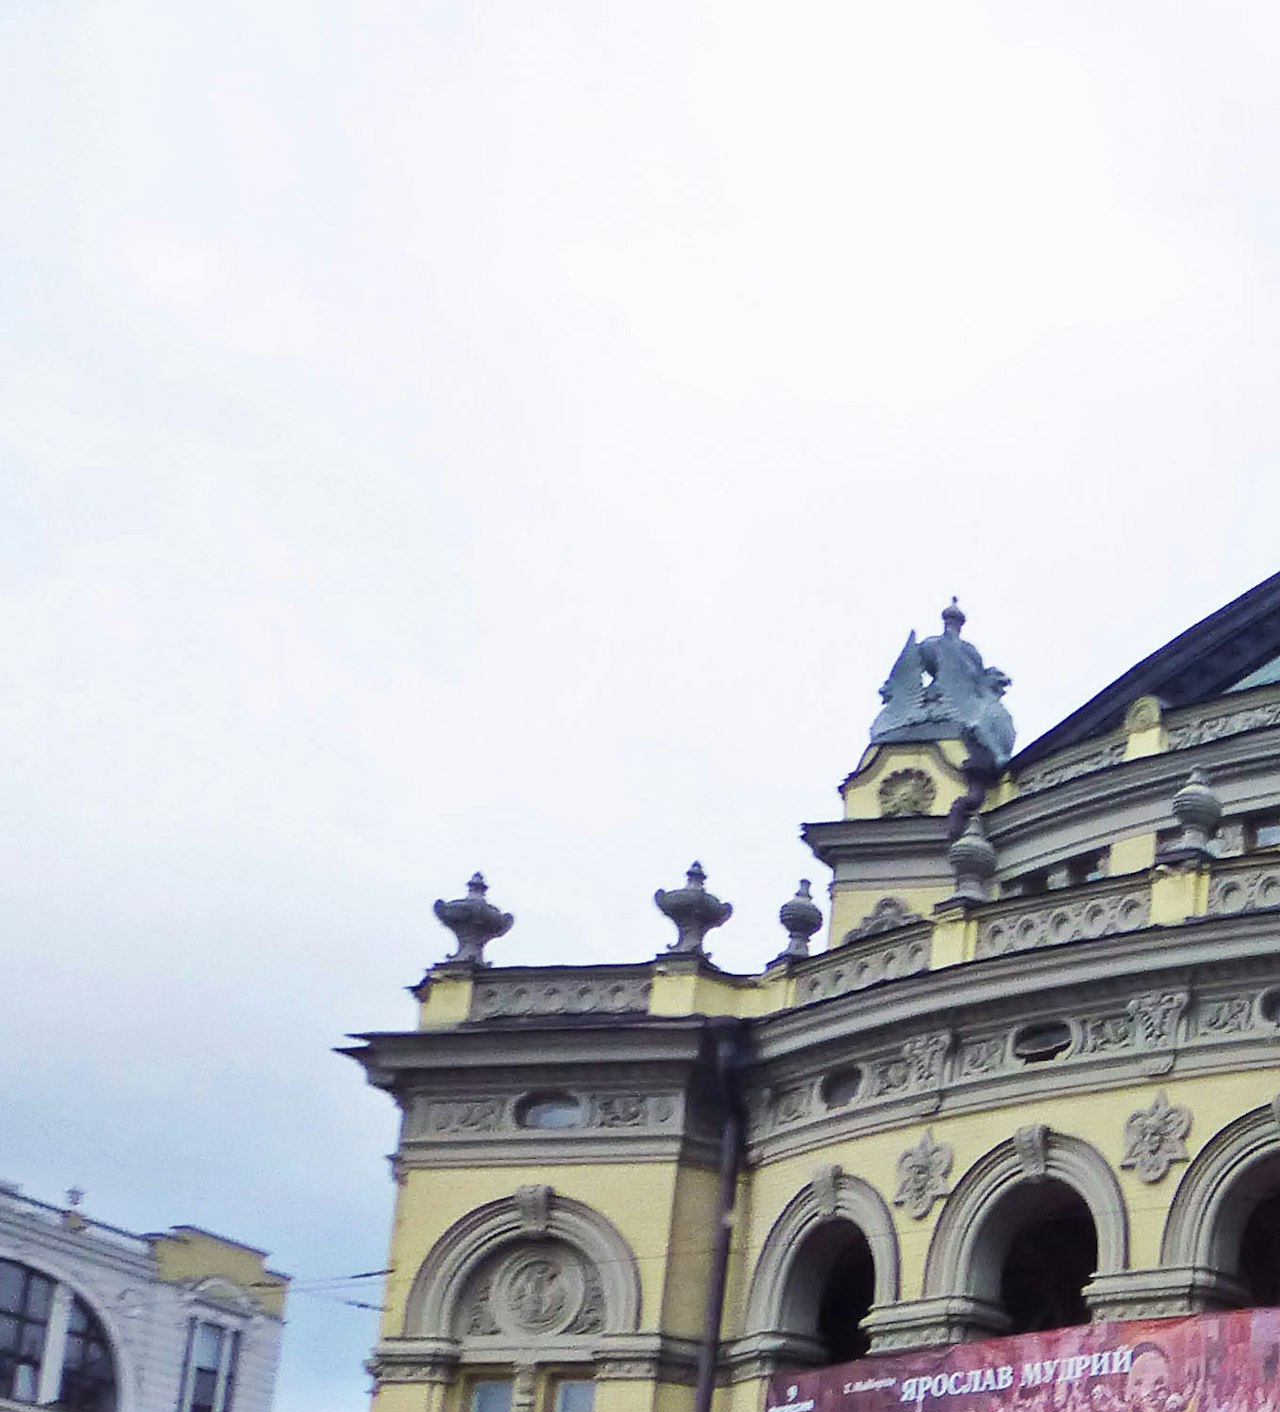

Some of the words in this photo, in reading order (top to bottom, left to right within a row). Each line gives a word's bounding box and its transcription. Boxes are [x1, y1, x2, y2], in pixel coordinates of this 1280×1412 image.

[786, 1384, 799, 1402] 9
[900, 1364, 1014, 1403] ЯРОСЛАВ
[1019, 1345, 1134, 1388] МУДРИЙ
